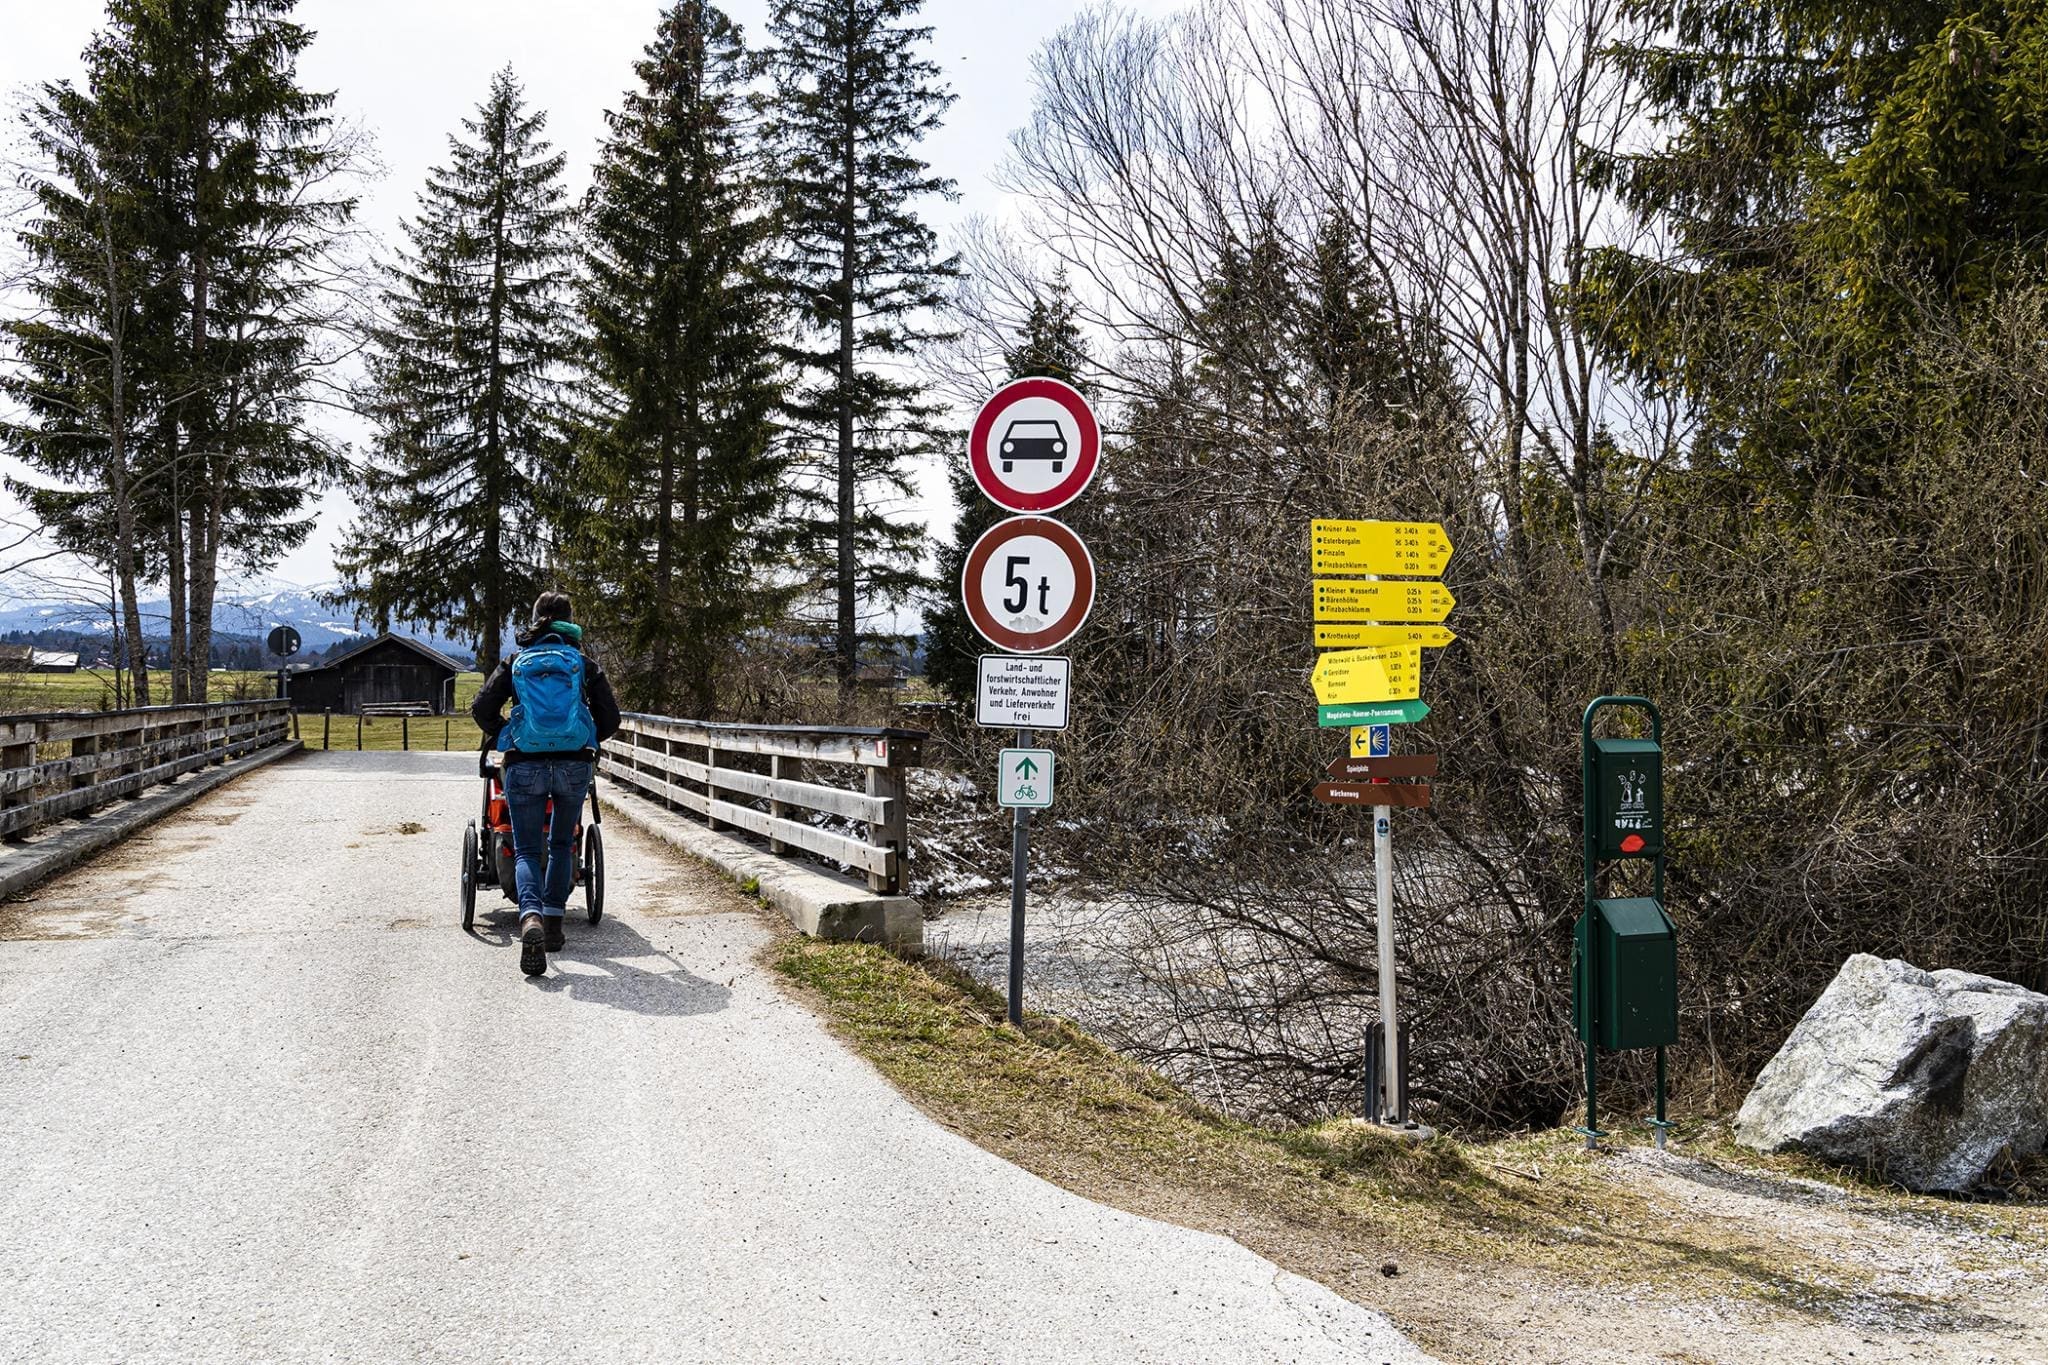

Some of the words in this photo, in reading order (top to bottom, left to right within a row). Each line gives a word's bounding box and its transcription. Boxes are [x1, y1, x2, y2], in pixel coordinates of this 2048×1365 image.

[1323, 537, 1361, 545] Esterbergalm
[1324, 561, 1368, 569] Finzbachklamm
[1003, 556, 1030, 615] 5
[1037, 576, 1051, 616] t
[1350, 587, 1379, 595] Wasserfall
[1326, 596, 1359, 604] Bärenhöhle
[1326, 606, 1370, 614] Finzbachklamm
[1327, 632, 1360, 640] Krottenkopf
[1005, 662, 1027, 672] Land-
[1029, 663, 1043, 673] und
[986, 674, 1061, 686] forstwirtschaftlicher
[1021, 687, 1058, 698] Anwohner
[989, 699, 1003, 708] und
[1006, 698, 1056, 710] Lieferverkehr
[1013, 711, 1031, 721] frei
